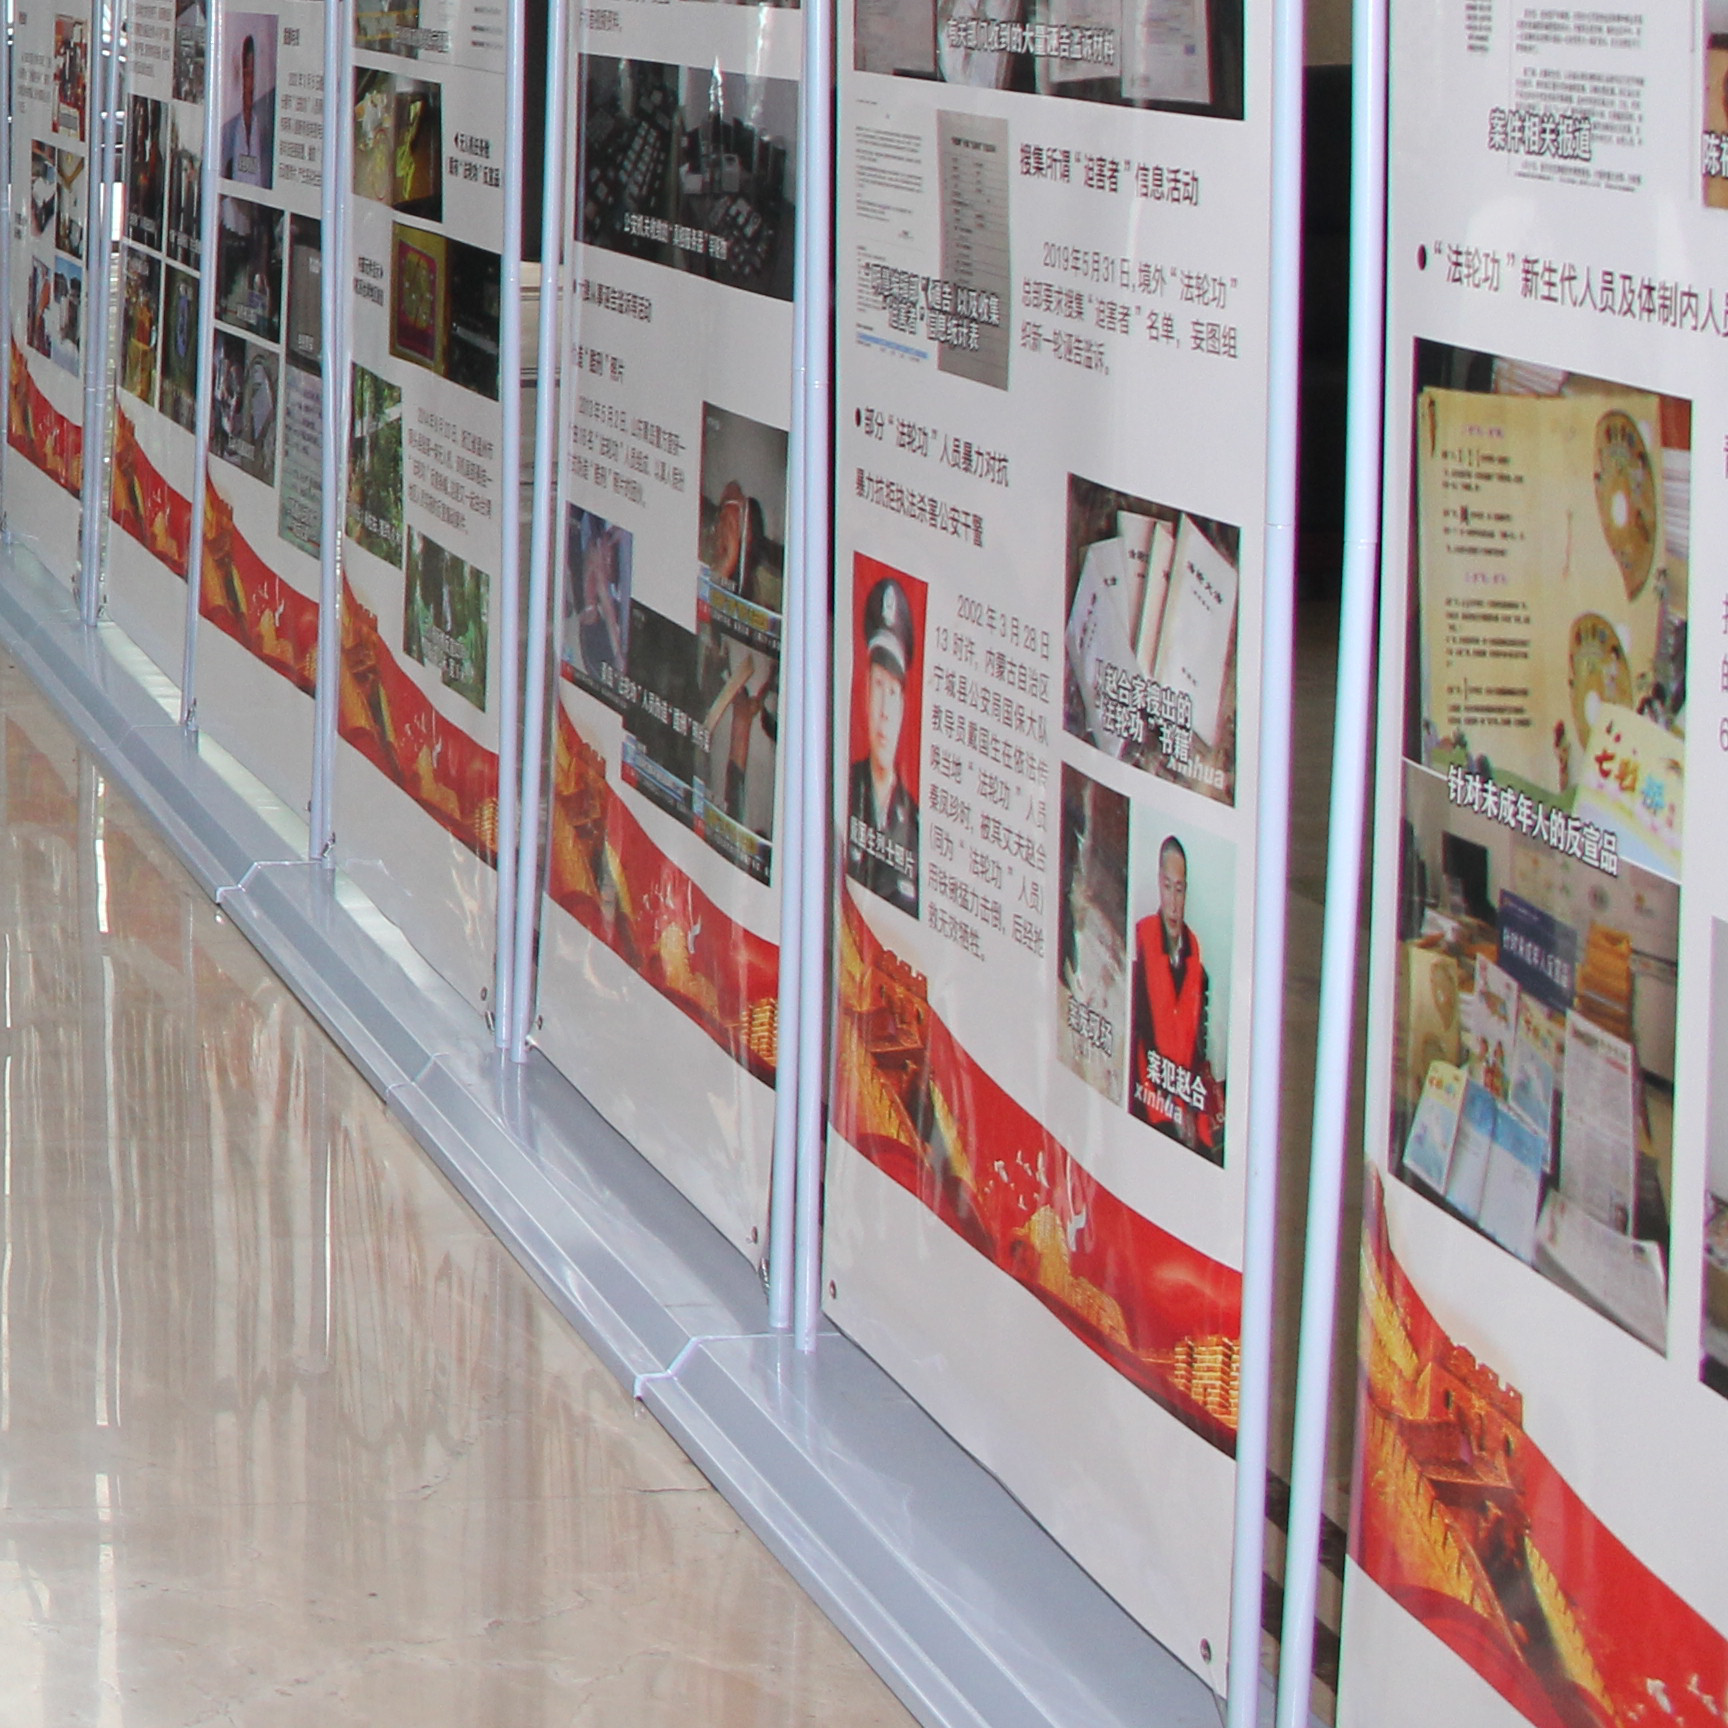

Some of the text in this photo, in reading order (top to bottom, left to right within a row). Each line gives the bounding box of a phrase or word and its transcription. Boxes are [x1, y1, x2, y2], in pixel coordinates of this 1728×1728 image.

[1488, 107, 1593, 162] 案件相关报道
[1447, 764, 1620, 877] 针对未成年人的反宣品
[1133, 1080, 1184, 1126] xinhua
